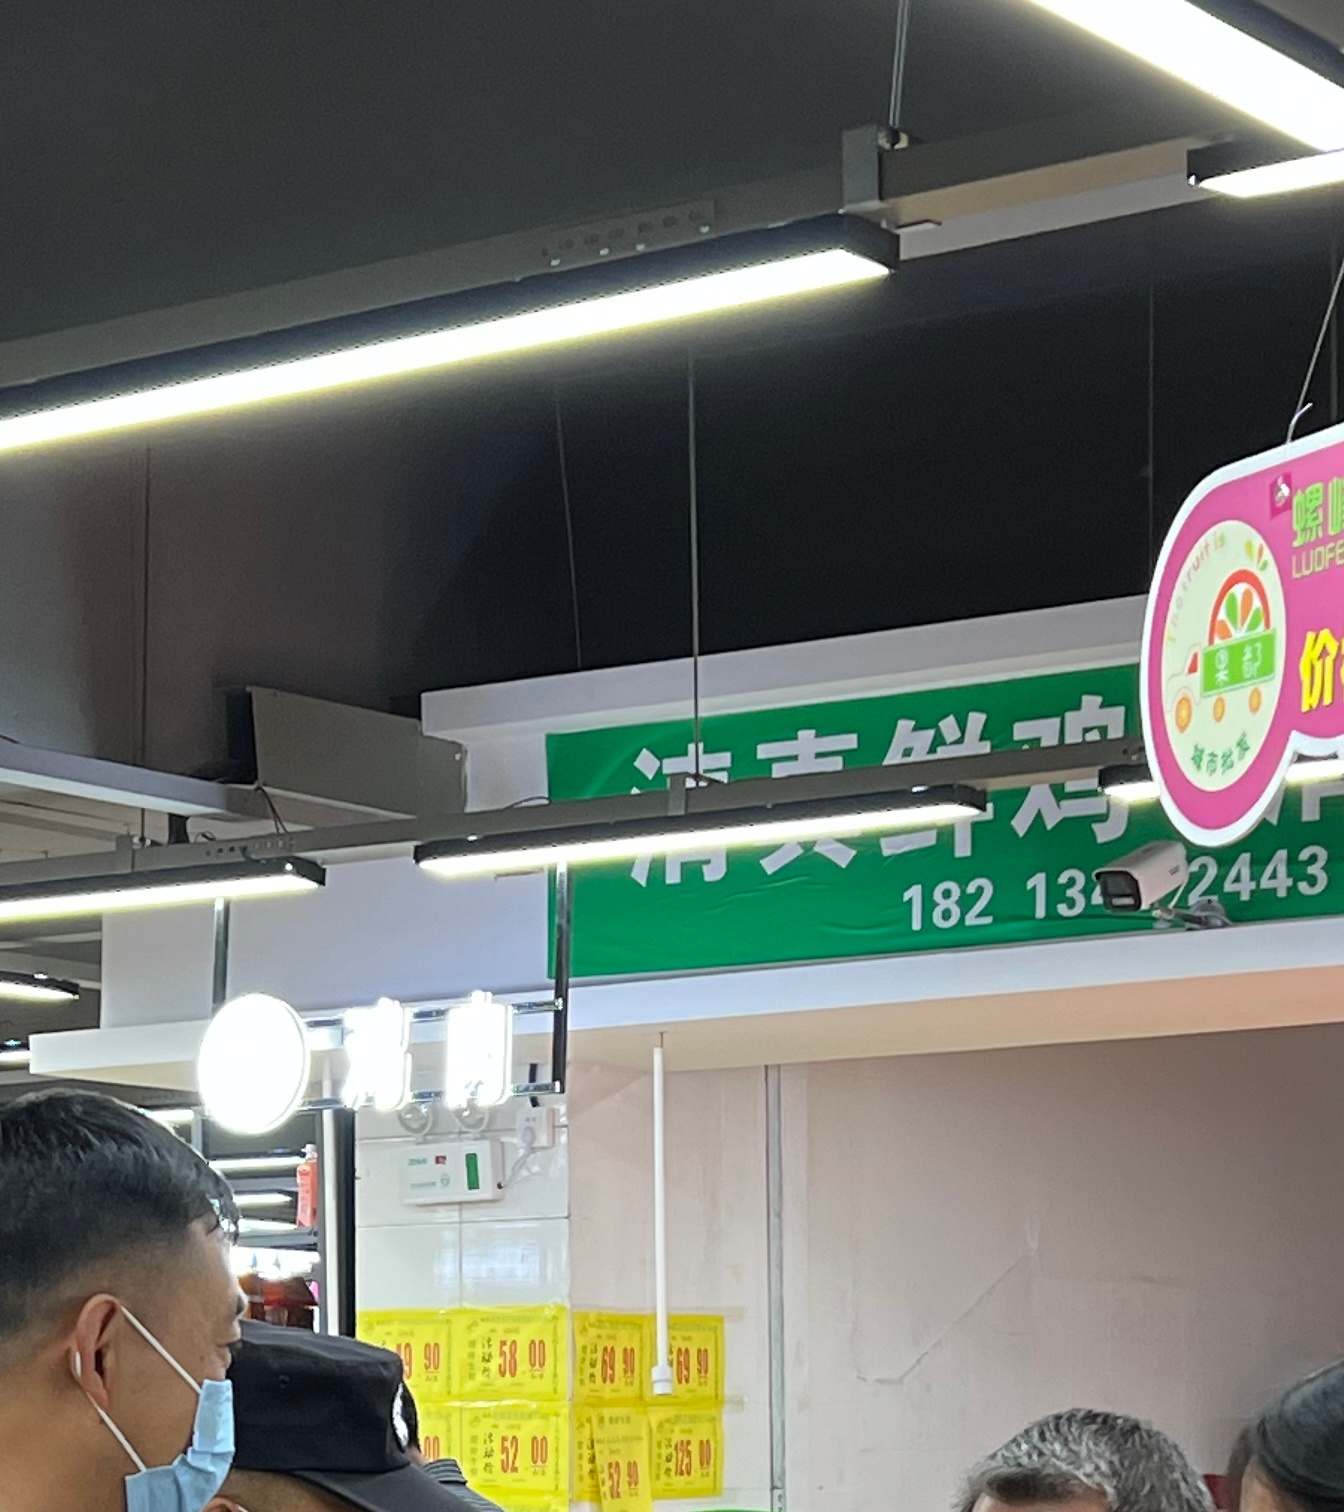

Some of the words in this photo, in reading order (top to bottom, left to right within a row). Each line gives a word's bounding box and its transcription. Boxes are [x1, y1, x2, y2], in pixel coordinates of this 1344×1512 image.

[903, 879, 994, 932] 182
[1027, 868, 1105, 920] 13
[1188, 845, 1329, 907] 2443
[498, 1339, 518, 1378] 58
[500, 1435, 519, 1474] 52
